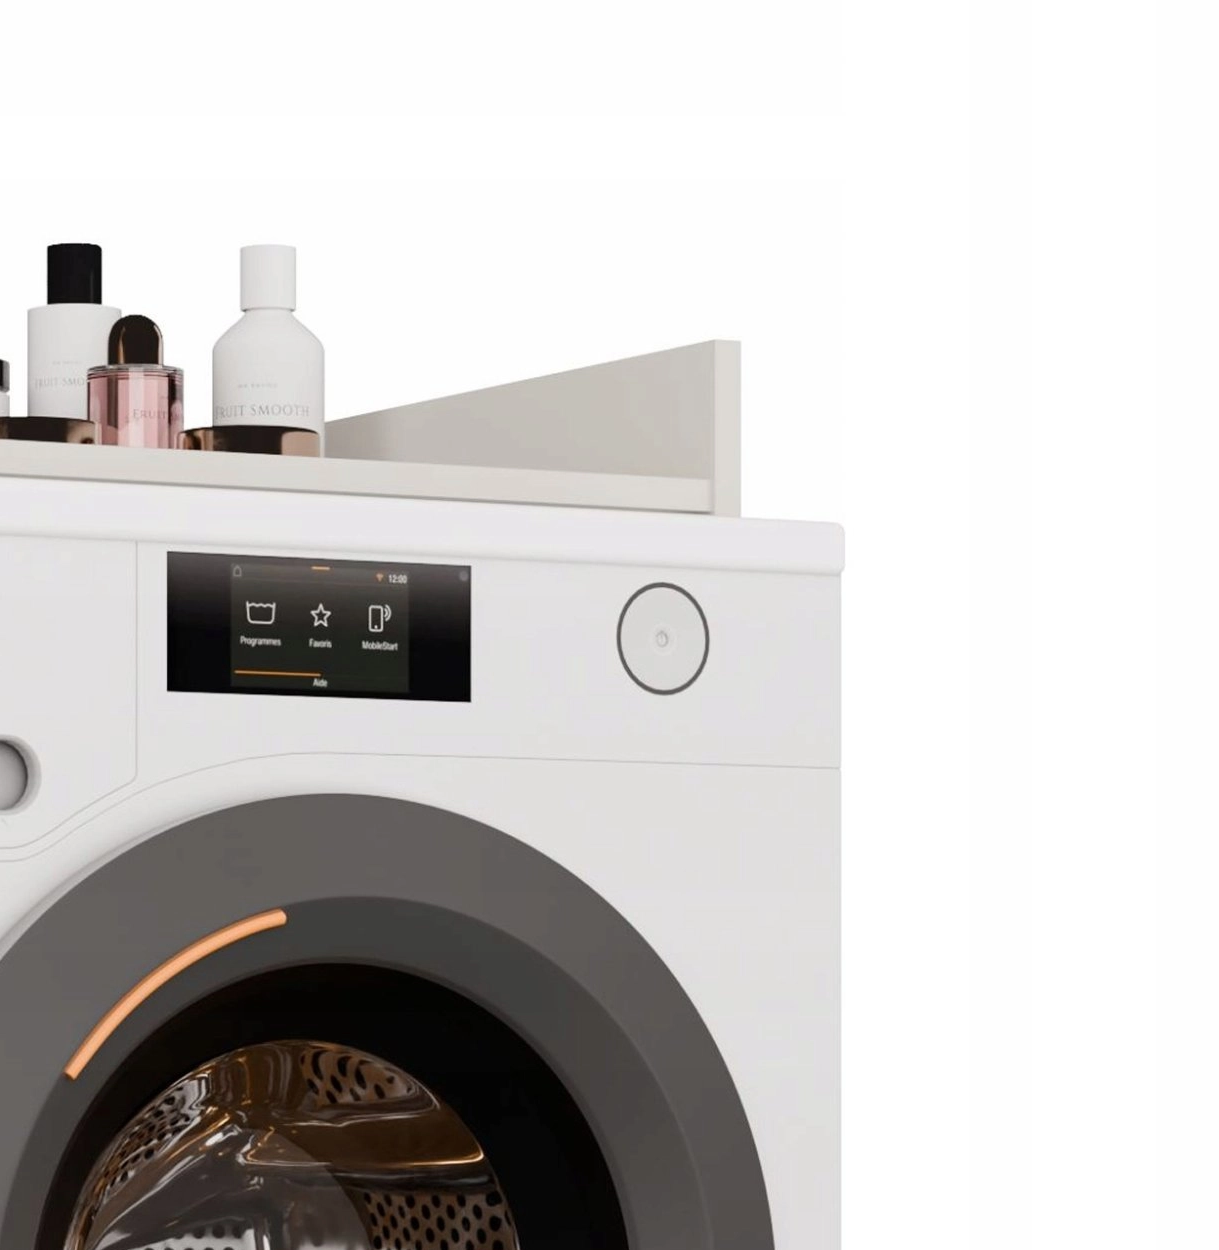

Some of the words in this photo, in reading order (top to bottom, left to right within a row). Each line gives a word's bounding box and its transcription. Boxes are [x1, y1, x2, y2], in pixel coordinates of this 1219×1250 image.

[62, 377, 85, 387] SMO
[215, 404, 245, 420] FRUIT
[251, 403, 310, 417] SMOOTH
[388, 574, 408, 585] 12:00
[239, 635, 282, 647] Programmes
[308, 638, 332, 649] Favoris
[361, 640, 399, 651] MobileStart
[313, 678, 328, 688] Aide
